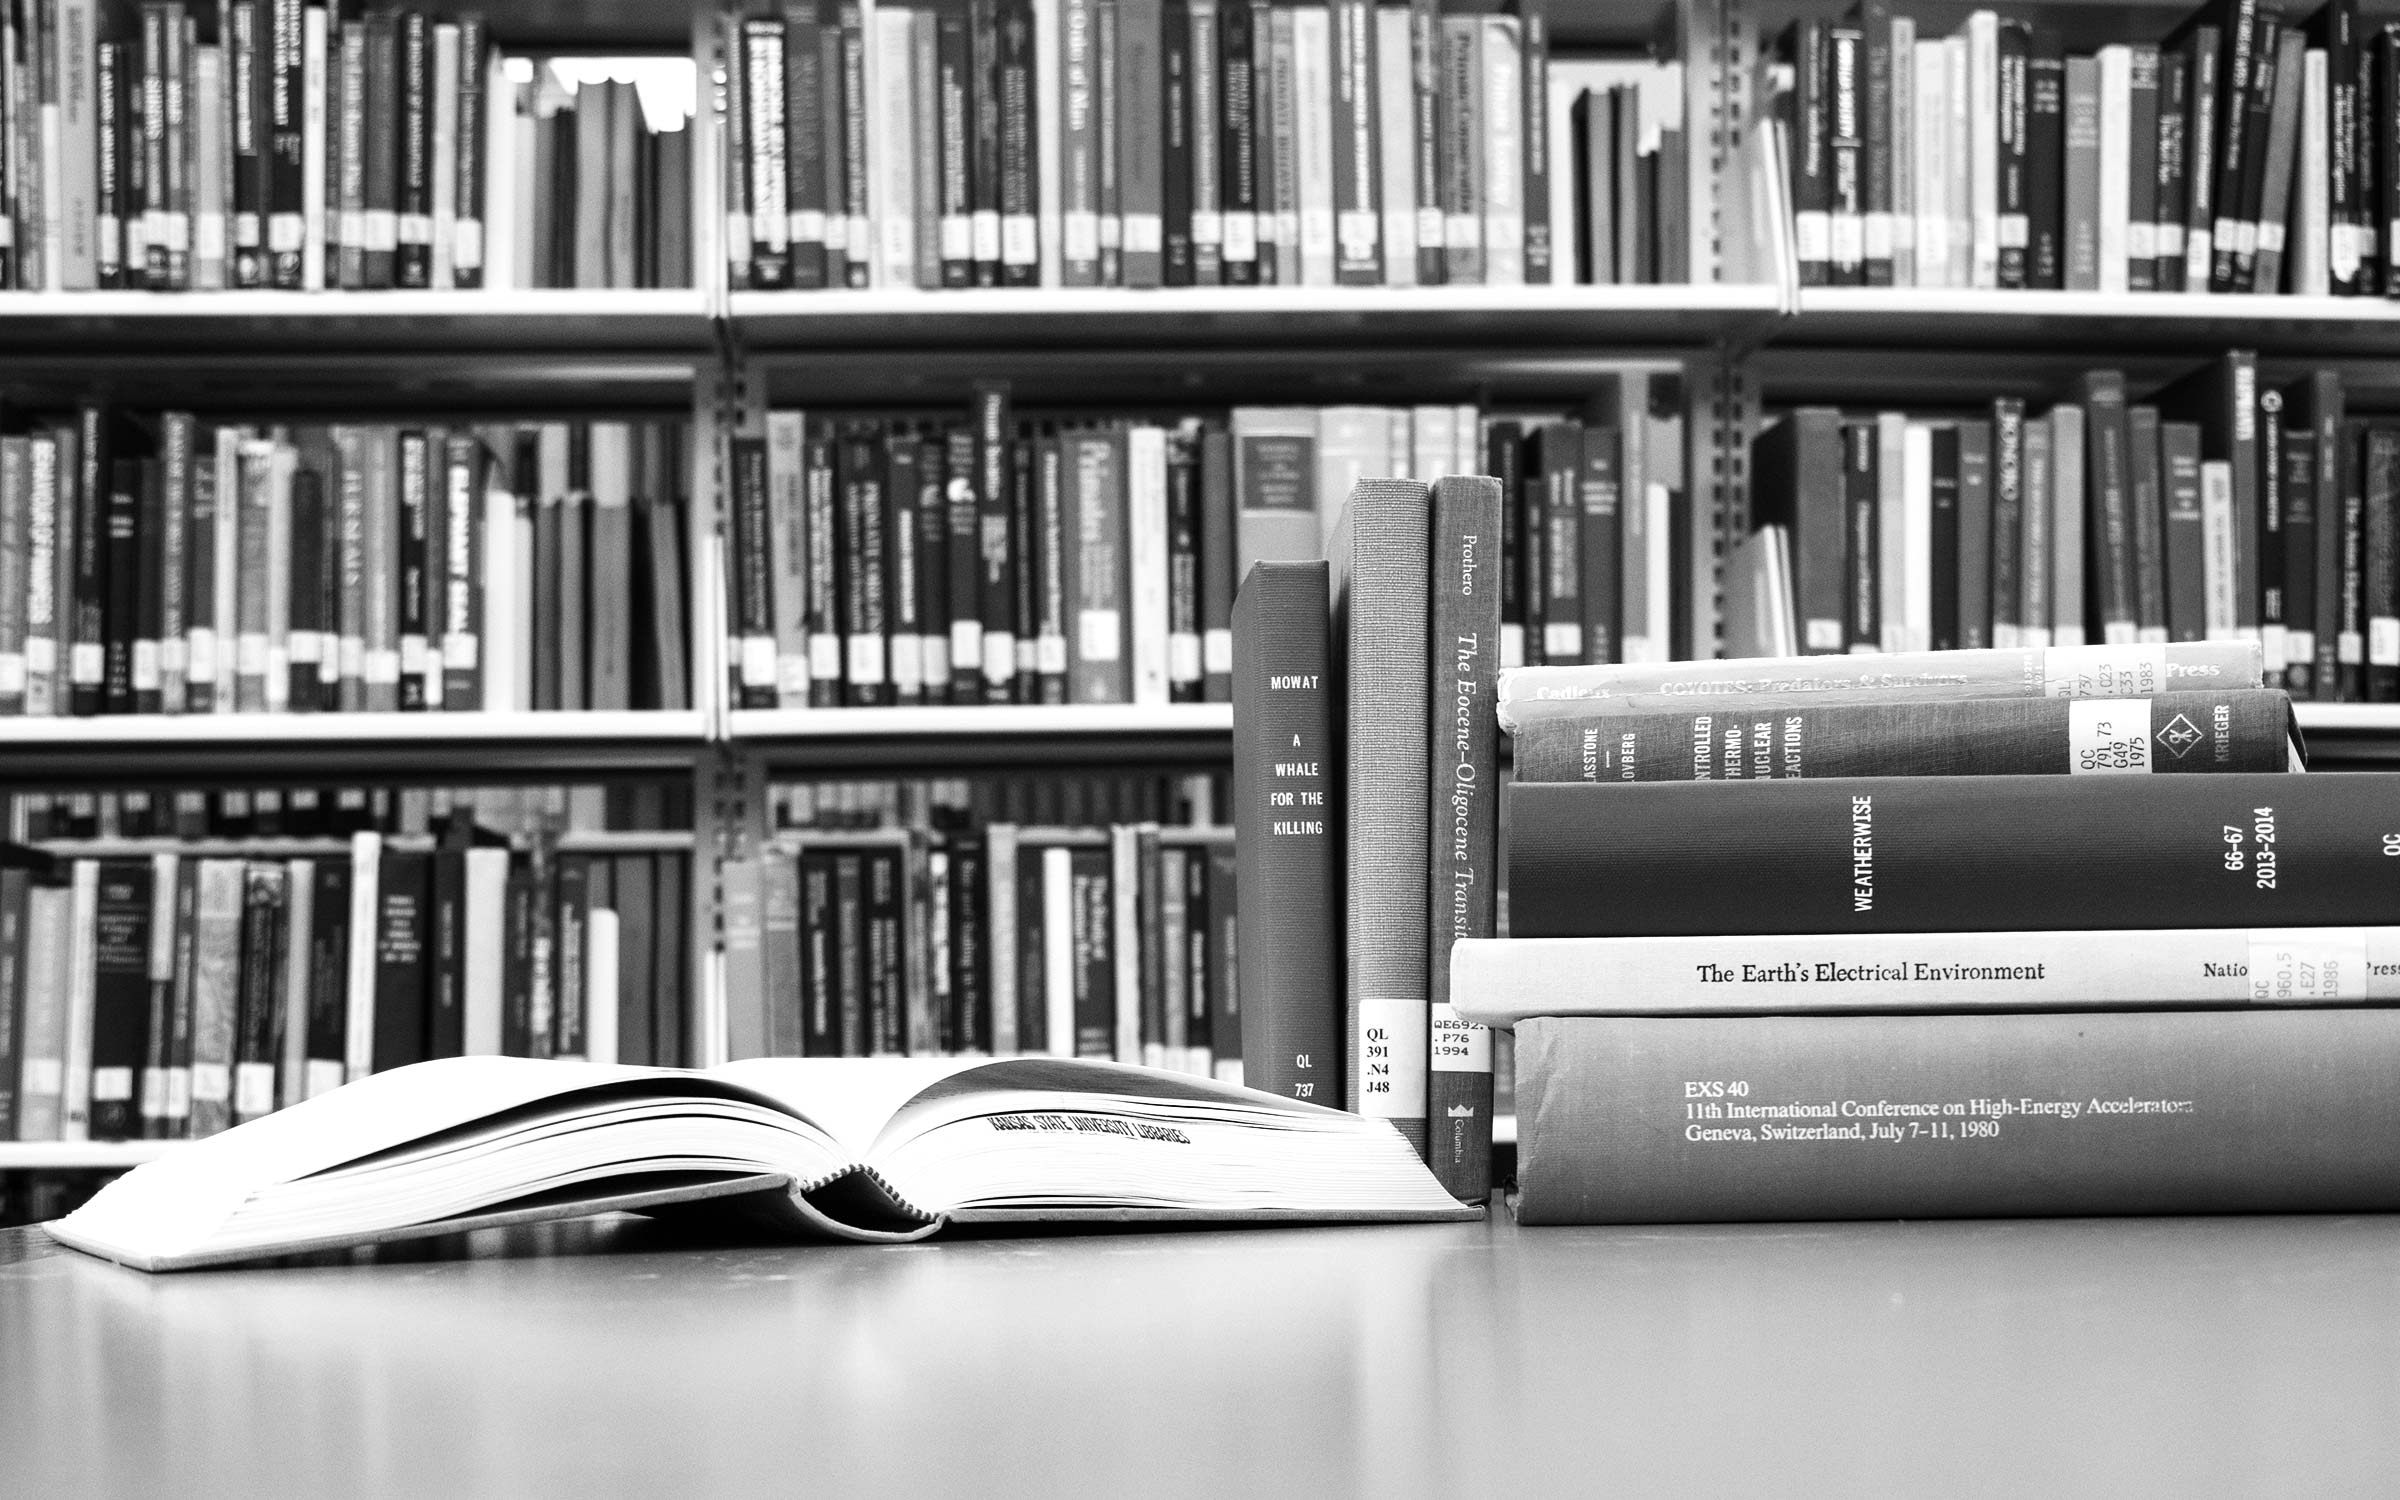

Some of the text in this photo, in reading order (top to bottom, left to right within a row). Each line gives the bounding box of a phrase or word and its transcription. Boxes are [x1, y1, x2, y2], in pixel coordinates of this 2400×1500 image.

[1462, 534, 1477, 596] Prothero
[1457, 632, 1477, 671] The
[2139, 661, 2153, 694] 1983
[2166, 662, 2222, 678] Press
[1270, 674, 1319, 691] MOWAT
[2078, 674, 2092, 697] 737
[1292, 733, 1301, 747] A
[2212, 704, 2230, 762] KRIEGER
[1583, 728, 1598, 782] ASSTONE
[1621, 733, 1636, 782] OVBERG
[2081, 749, 2096, 770] QC
[2113, 741, 2128, 769] G49
[2129, 737, 2145, 769] 1975
[1275, 762, 1319, 777] WHALE
[1270, 791, 1323, 807] FOR THE
[1273, 821, 1323, 836] KILLING
[1852, 795, 1873, 912] WEATHERWISE
[2223, 825, 2244, 871] 66-67
[2253, 806, 2276, 889] 2013-2014
[1697, 961, 2045, 983] The Earth's Electrical Environment
[2203, 963, 2248, 977] Natio
[2277, 952, 2293, 998] 960.5
[2300, 962, 2315, 995] .E27
[2323, 960, 2339, 997] 1986
[2255, 980, 2270, 999] QC
[1366, 1028, 1389, 1042] QL
[1434, 1020, 1493, 1030] QE692.
[1434, 1034, 1470, 1043] .P76
[1296, 1054, 1312, 1069] QL
[1366, 1046, 1389, 1058] 391
[1434, 1046, 1469, 1056] 1994
[1366, 1064, 1389, 1076] .N4
[1295, 1083, 1314, 1098] 737
[1366, 1082, 1390, 1093] J48
[1684, 1080, 1749, 1097] EXS 40
[1685, 1095, 2194, 1119] 11th International Conference on High-Energy Accelerators
[987, 1114, 1191, 1145] KANSAS STATE UNIVERSITY LIBRARIES
[1685, 1124, 1757, 1142] Geneva,
[1760, 1122, 1866, 1141] Switzerland,
[1869, 1121, 1905, 1142] July
[1959, 1120, 2000, 1139] 1980
[1454, 1120, 1465, 1164] Columbia
